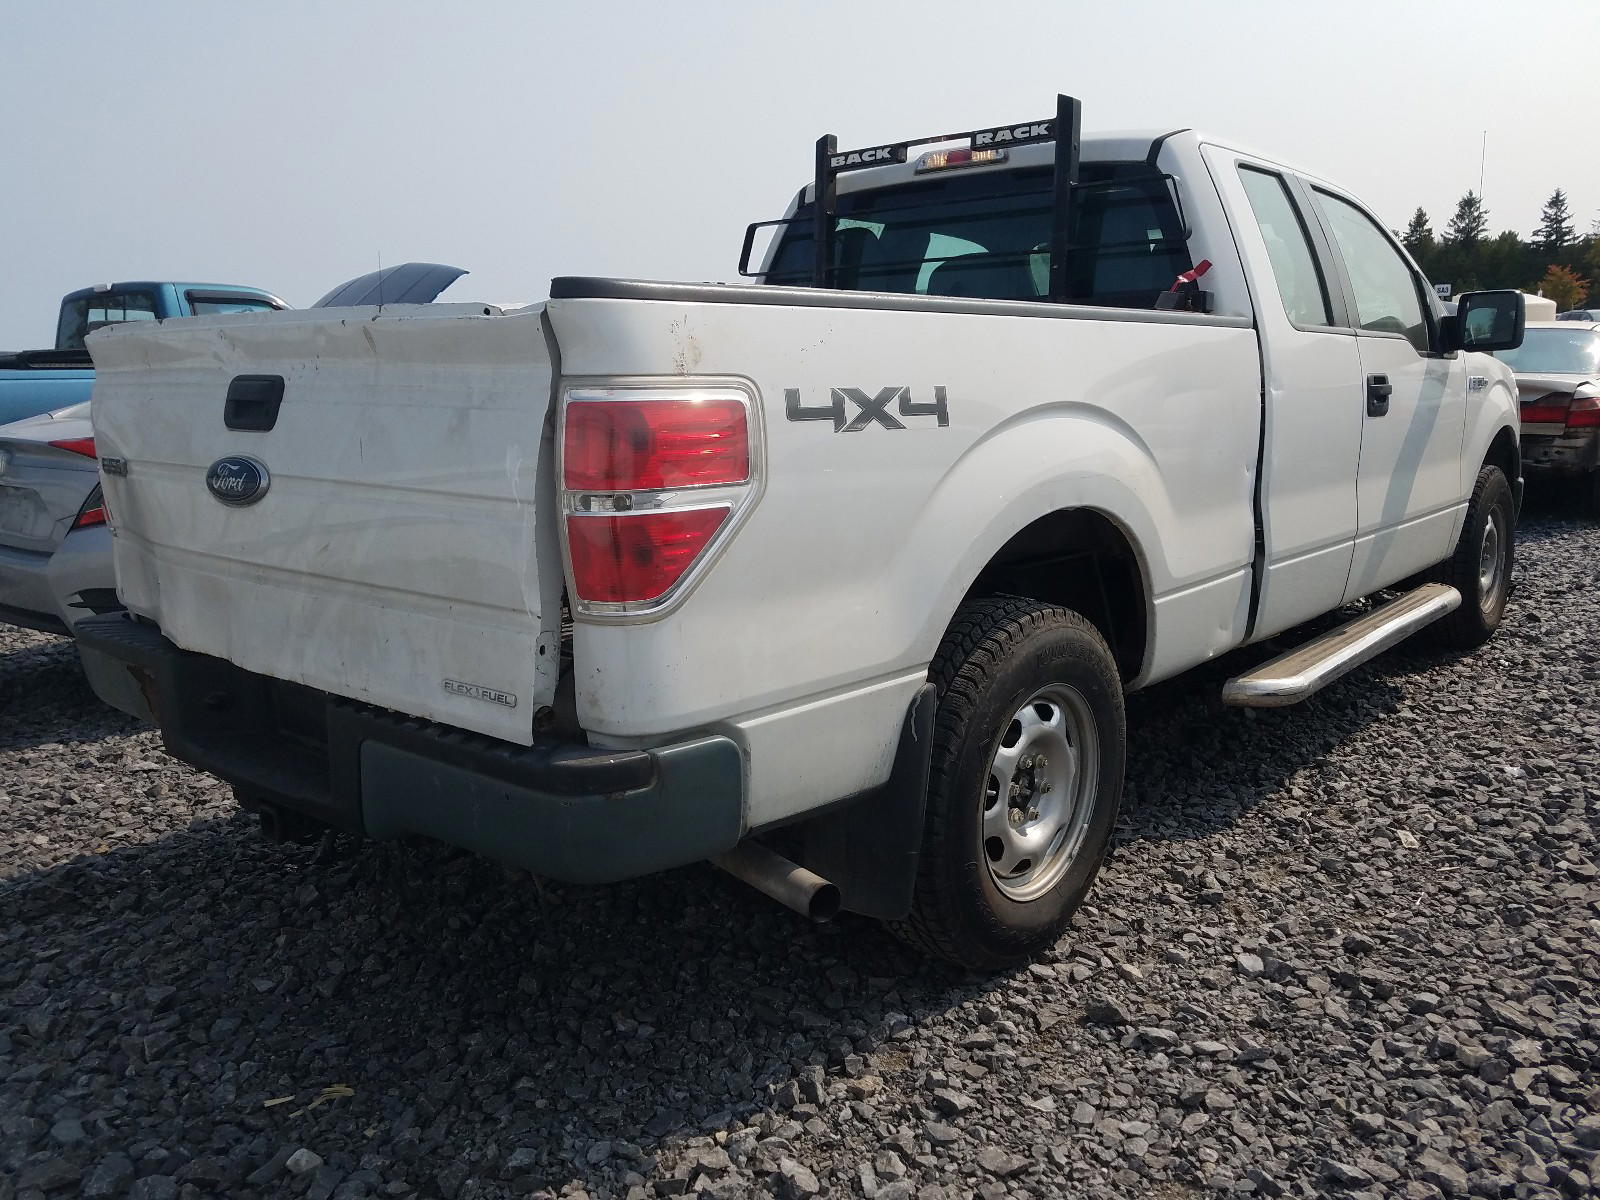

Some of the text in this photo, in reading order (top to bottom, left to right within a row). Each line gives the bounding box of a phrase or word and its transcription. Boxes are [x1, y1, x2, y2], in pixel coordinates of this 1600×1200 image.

[830, 123, 1050, 168] BACK RACK
[213, 462, 247, 492] Ford
[444, 681, 512, 705] FLEX FUEL
